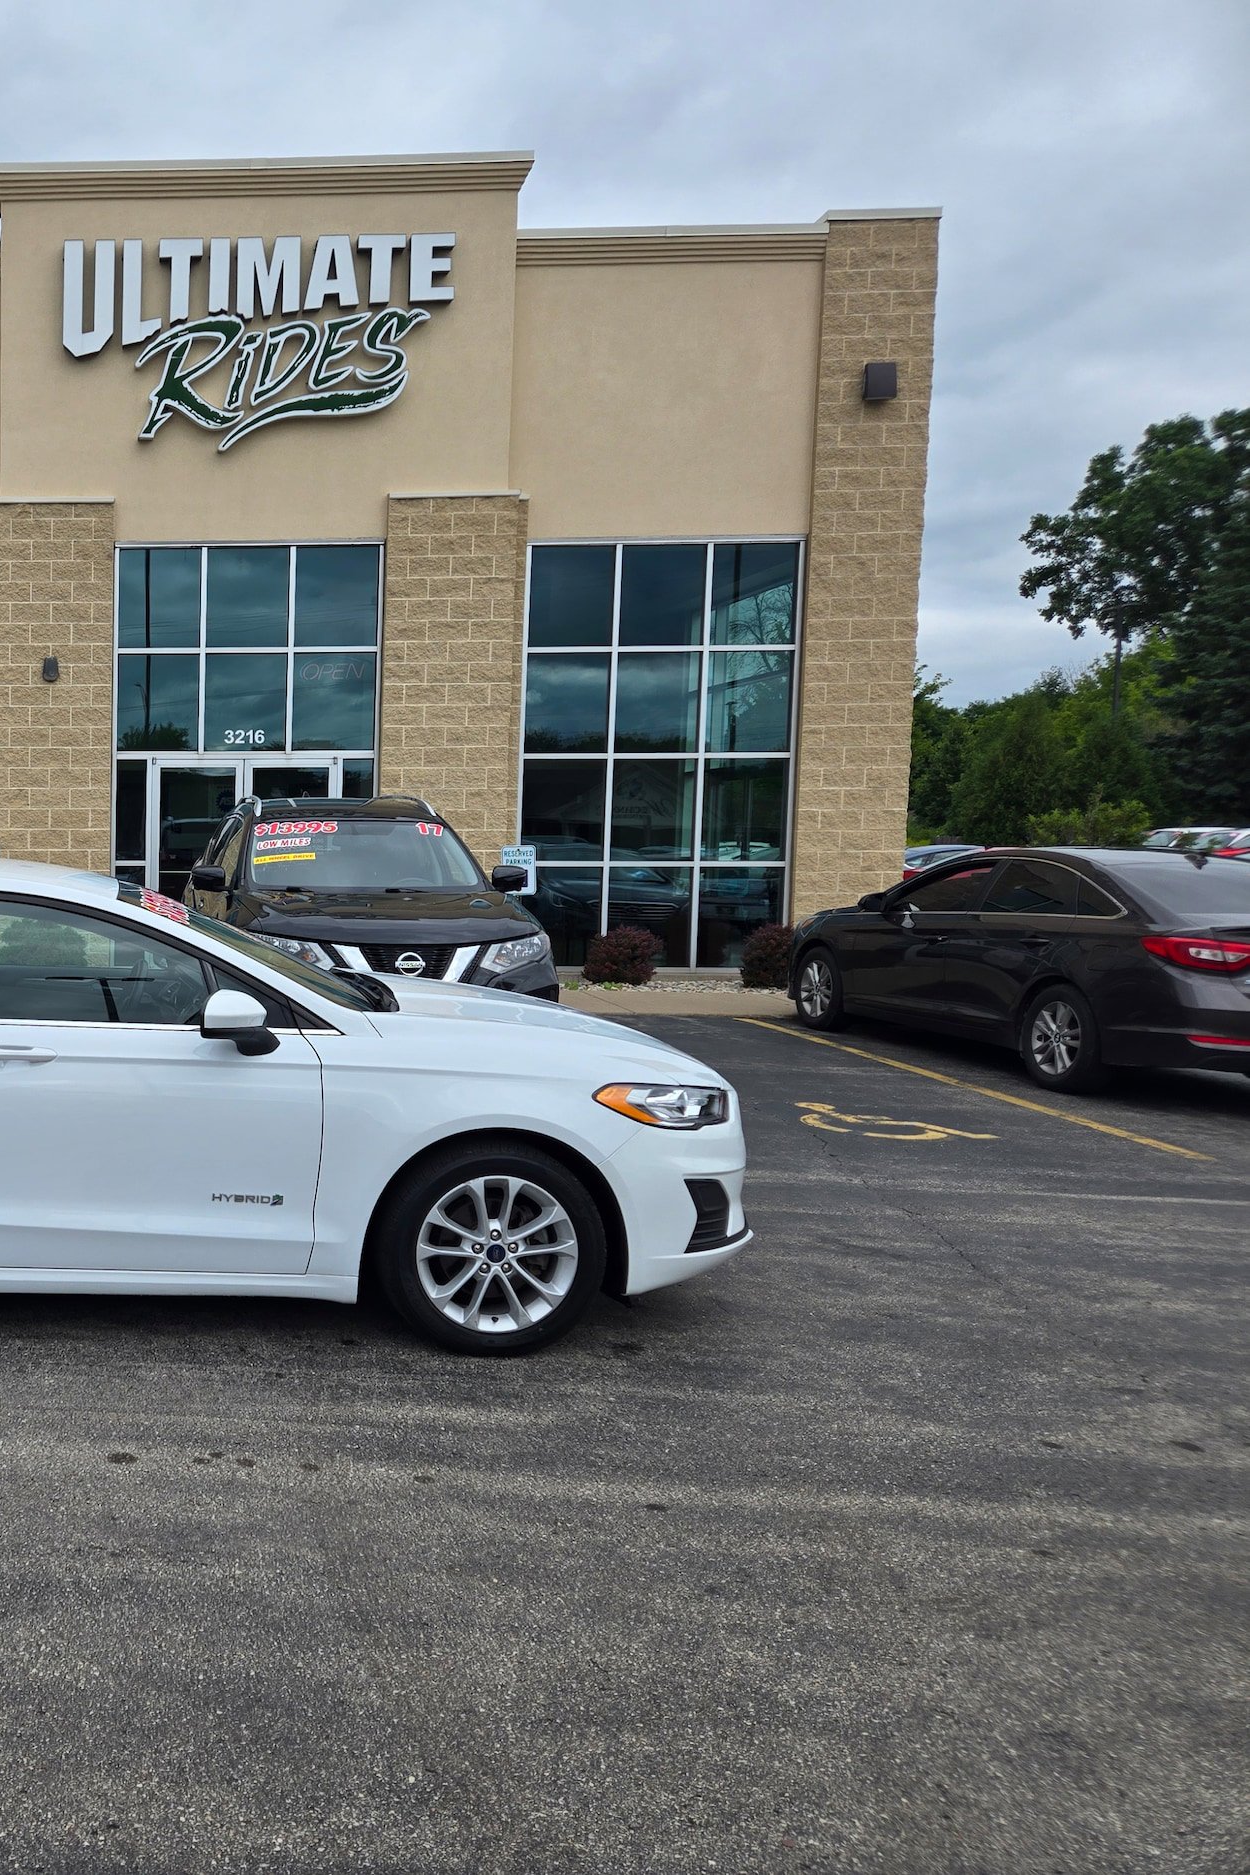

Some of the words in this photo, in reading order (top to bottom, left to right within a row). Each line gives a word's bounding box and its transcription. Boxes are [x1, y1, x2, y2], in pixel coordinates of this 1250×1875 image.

[62, 232, 456, 358] ULTIMATE
[302, 664, 365, 681] OPEN
[224, 729, 265, 744] 3216
[254, 821, 338, 836] $13995
[415, 822, 444, 836] 17
[257, 840, 279, 850] LOW
[280, 837, 311, 847] MILES
[211, 1193, 271, 1204] HYBRID
